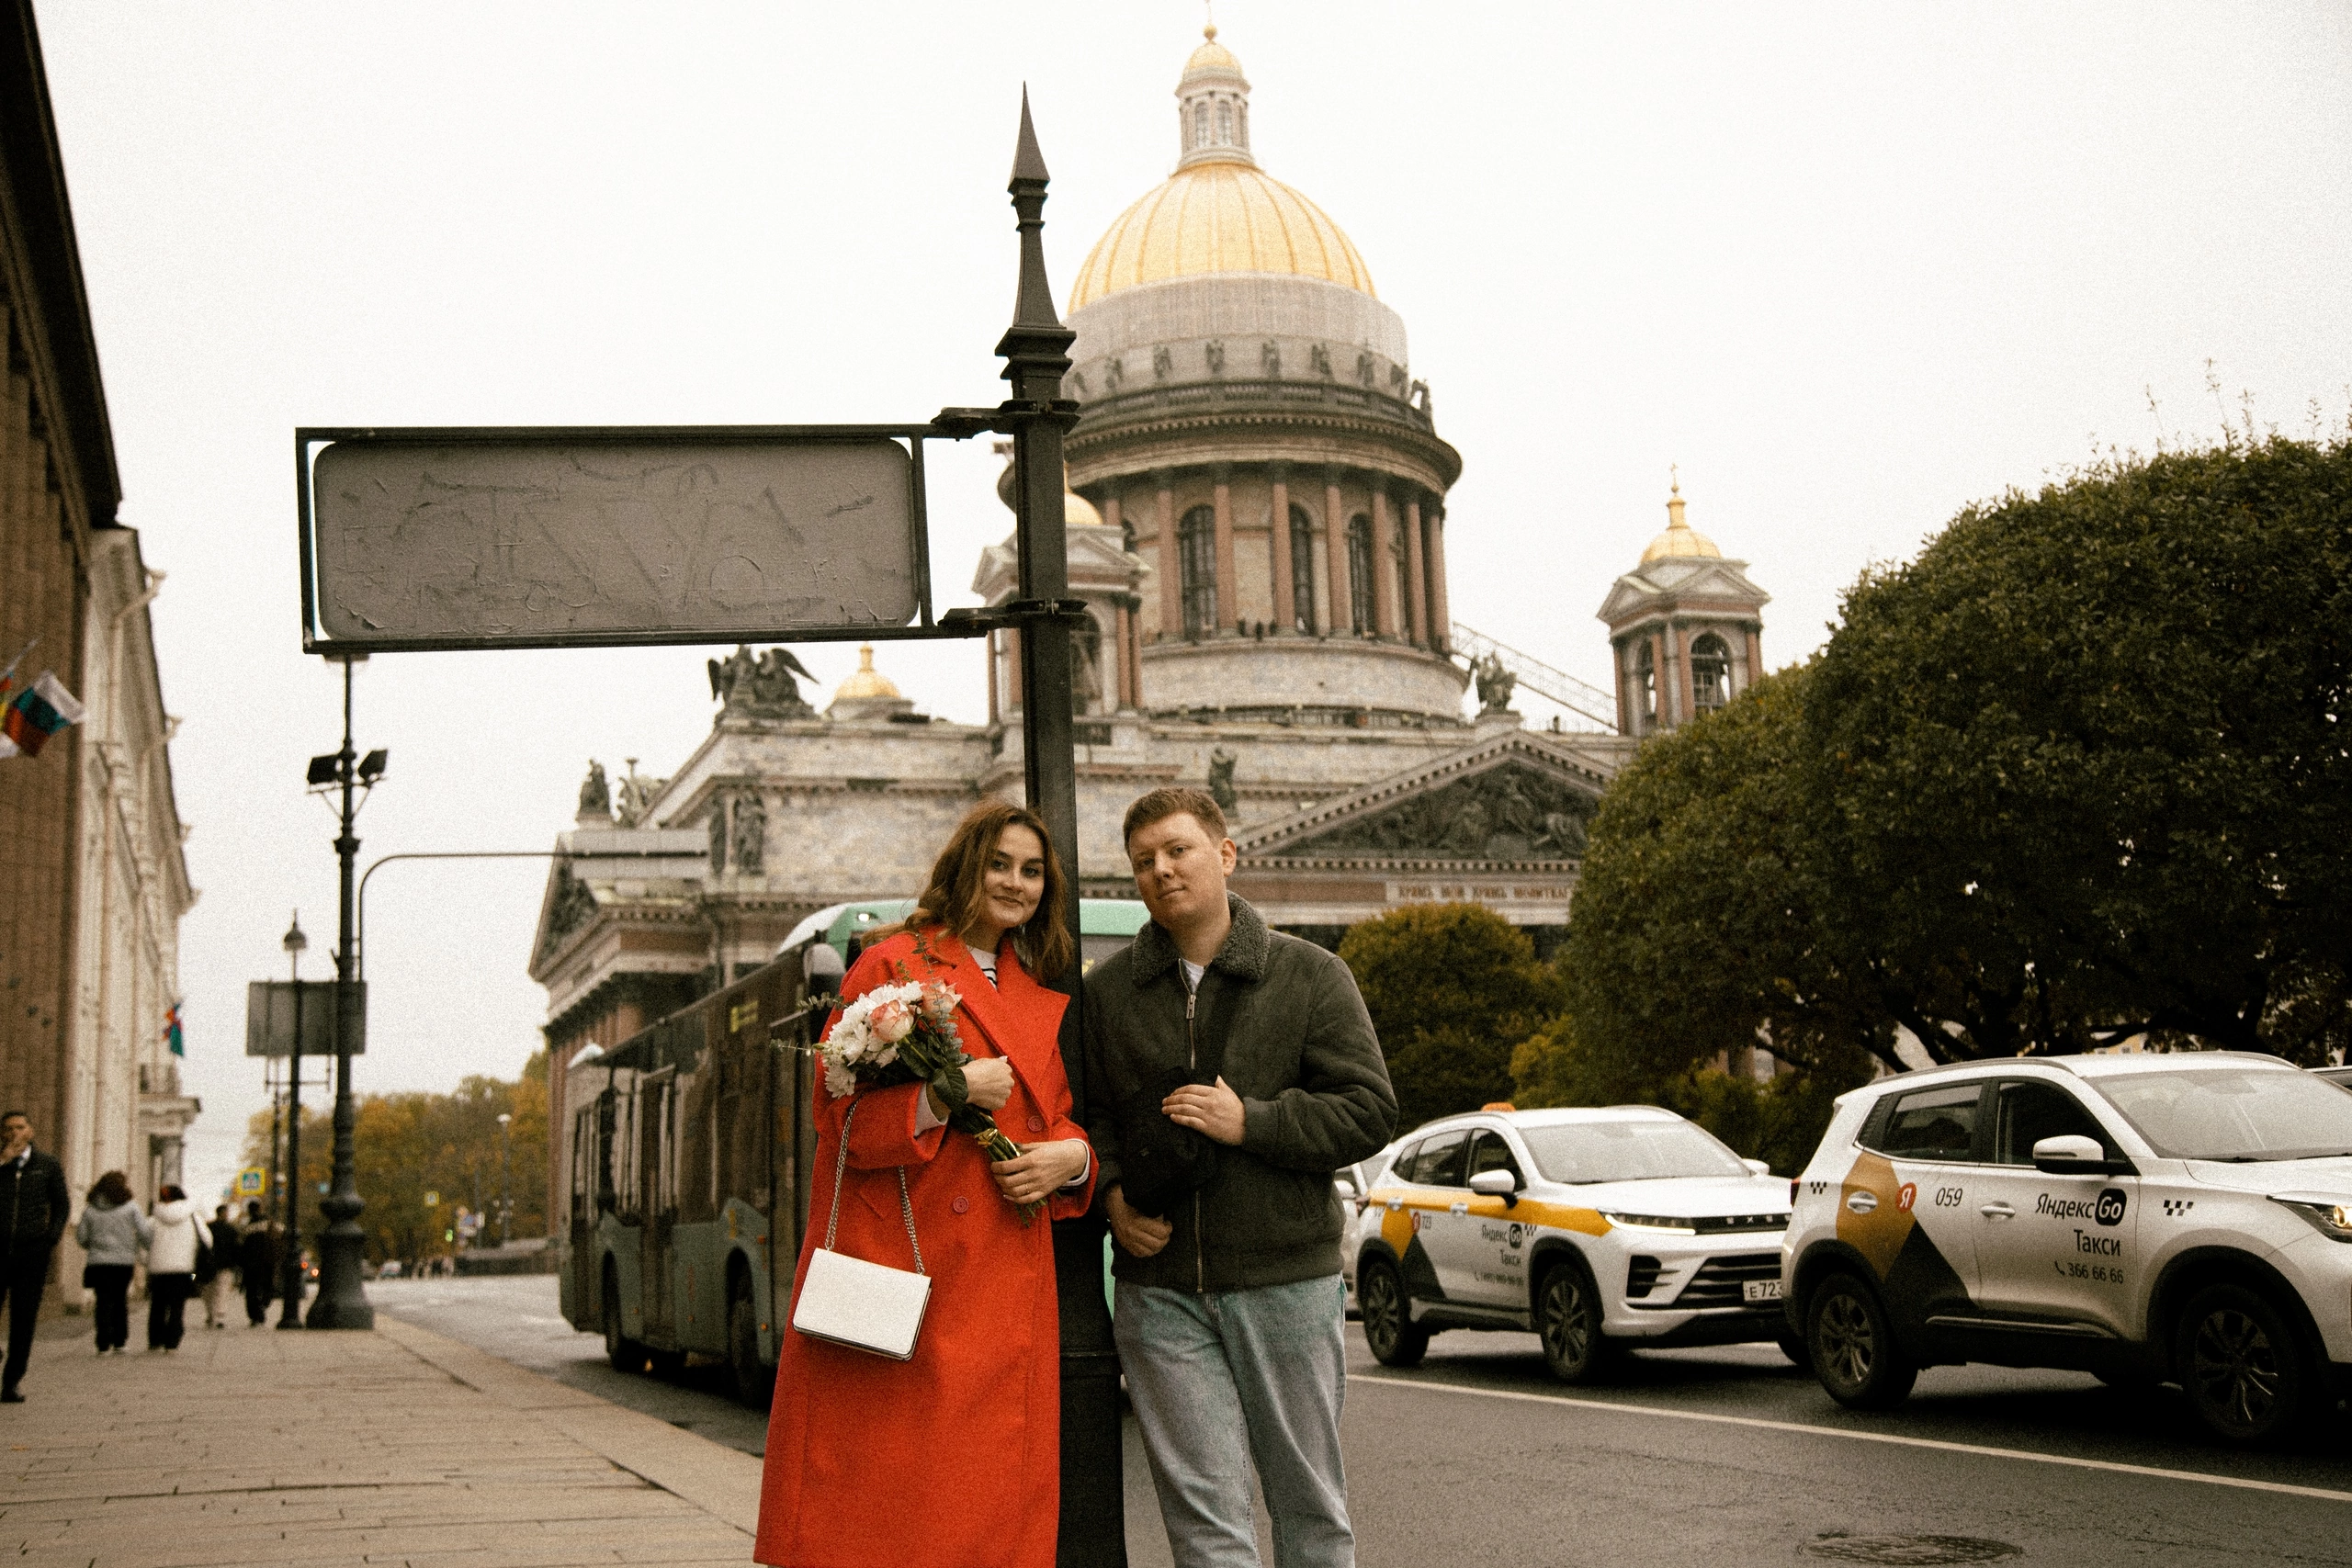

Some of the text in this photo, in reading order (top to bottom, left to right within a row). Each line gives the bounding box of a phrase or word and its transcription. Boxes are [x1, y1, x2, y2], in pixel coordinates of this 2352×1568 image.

[1899, 1187, 1913, 1209] Я
[1935, 1186, 1963, 1208] 059
[2035, 1192, 2123, 1220] Яндекс Go
[1481, 1224, 1508, 1244] Яндекс
[2074, 1228, 2121, 1257] Такси
[2067, 1262, 2124, 1284] 366 66 66
